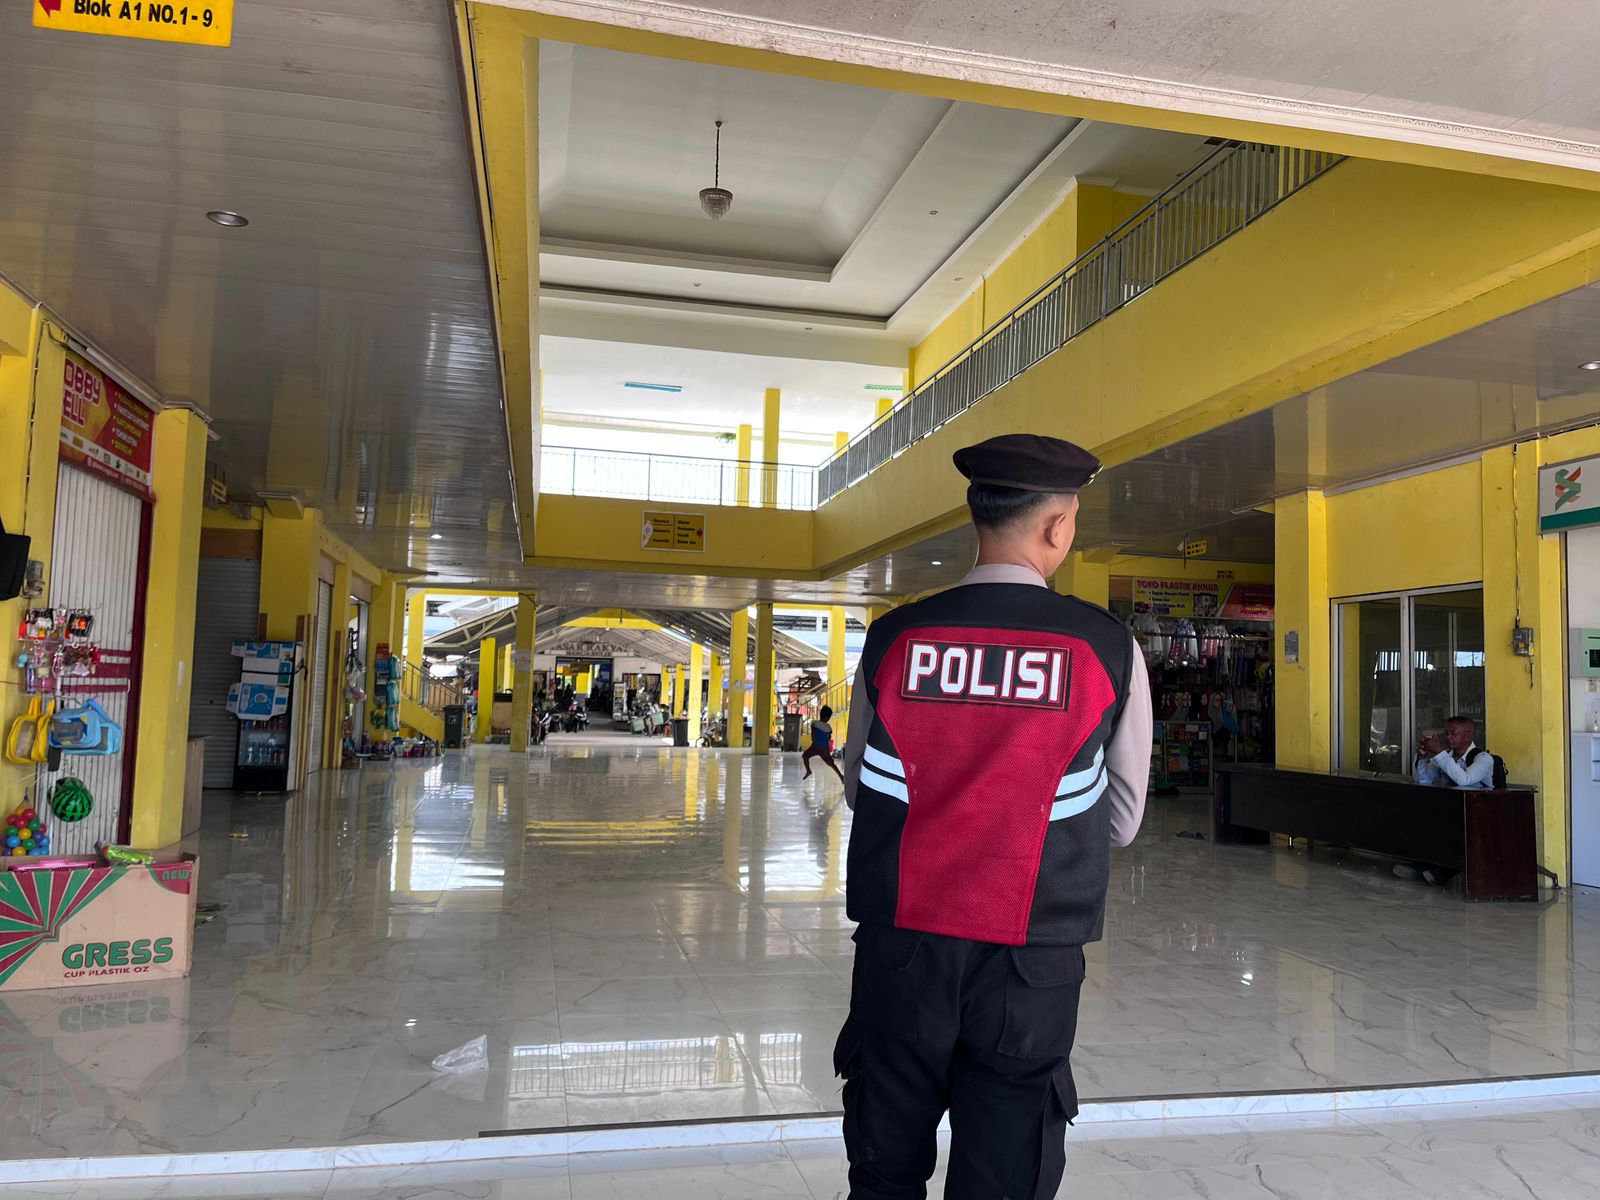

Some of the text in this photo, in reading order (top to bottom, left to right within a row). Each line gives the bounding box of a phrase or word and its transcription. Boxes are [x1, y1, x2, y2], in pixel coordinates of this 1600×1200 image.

[73, 0, 111, 17] Blok
[118, 1, 142, 22] A1
[1136, 580, 1160, 589] TOKO
[1160, 581, 1191, 591] PLASTIK
[906, 643, 1064, 703] POLISI
[61, 937, 174, 970] GRESS
[63, 965, 150, 979] CUP PLASTIK OZ
